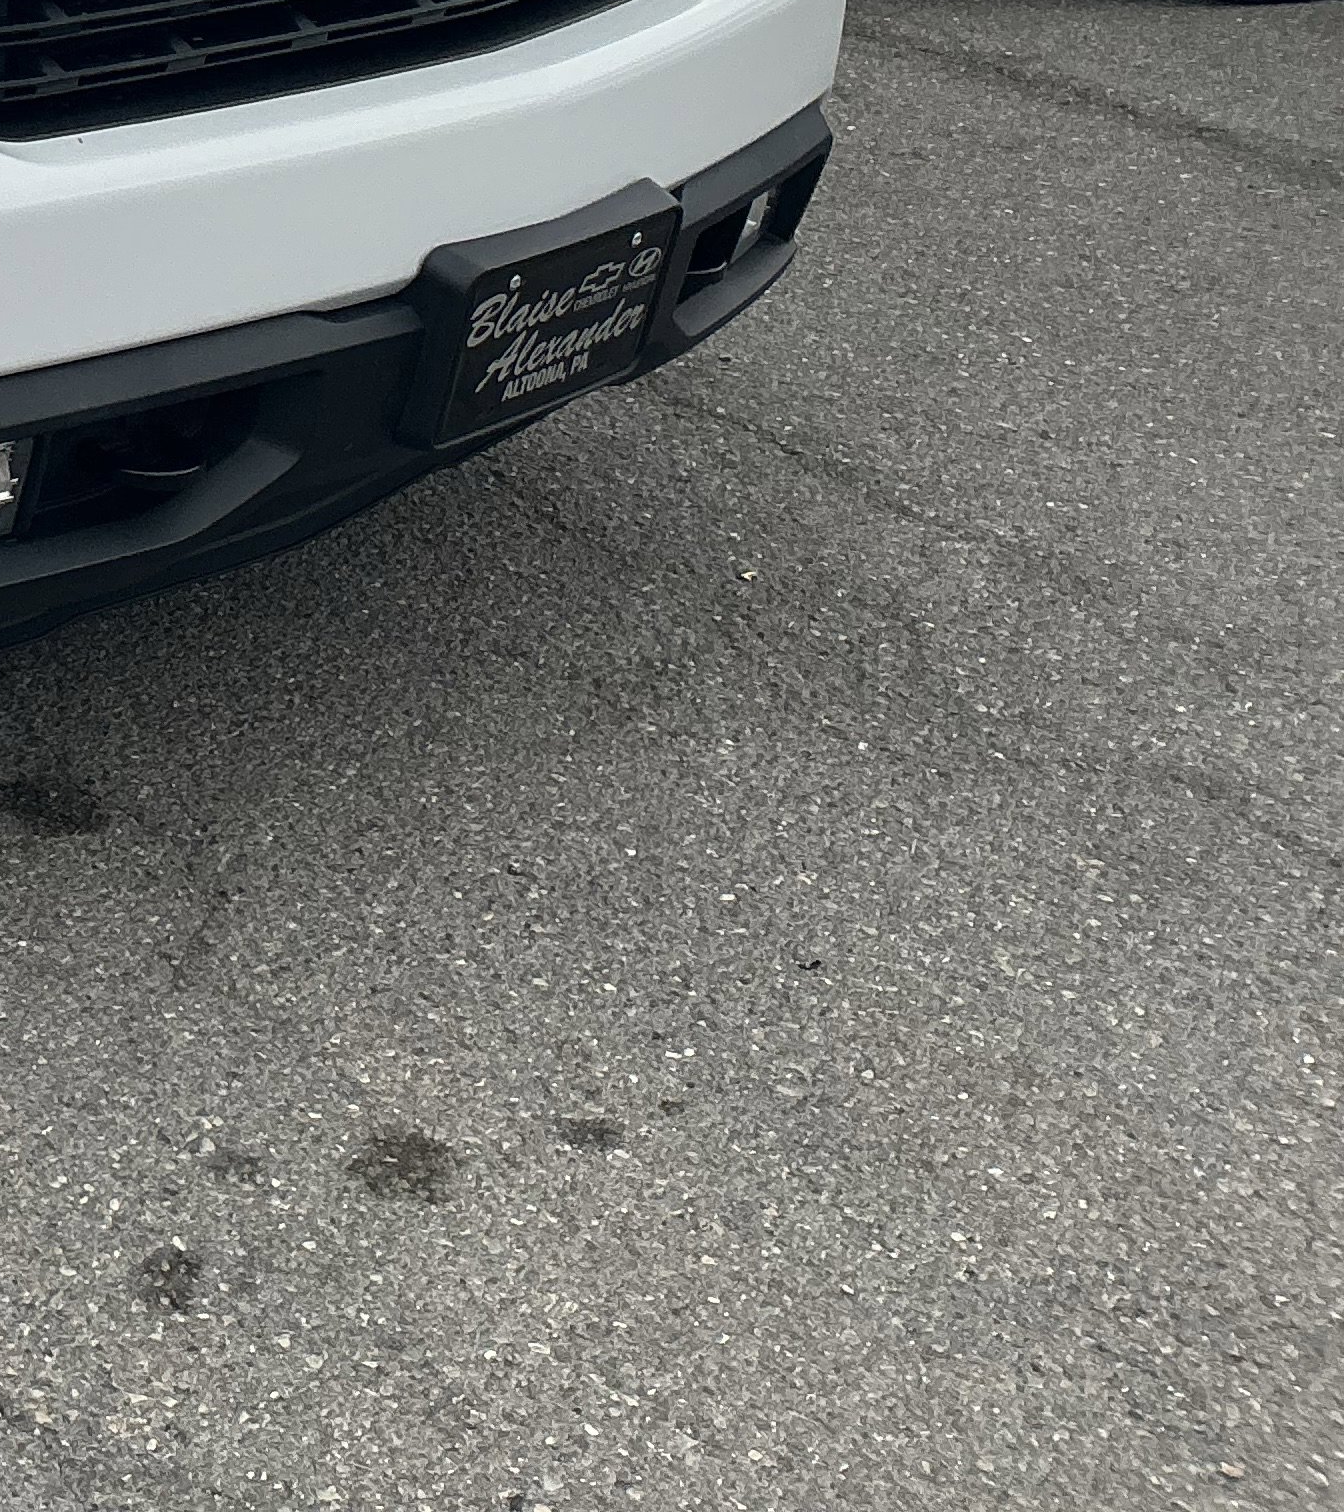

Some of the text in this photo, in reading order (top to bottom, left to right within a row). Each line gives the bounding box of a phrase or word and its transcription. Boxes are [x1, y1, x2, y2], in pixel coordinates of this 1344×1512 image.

[466, 288, 577, 348] Blaise
[475, 298, 646, 394] Alexander
[501, 350, 591, 403] ALTOONA, PA
